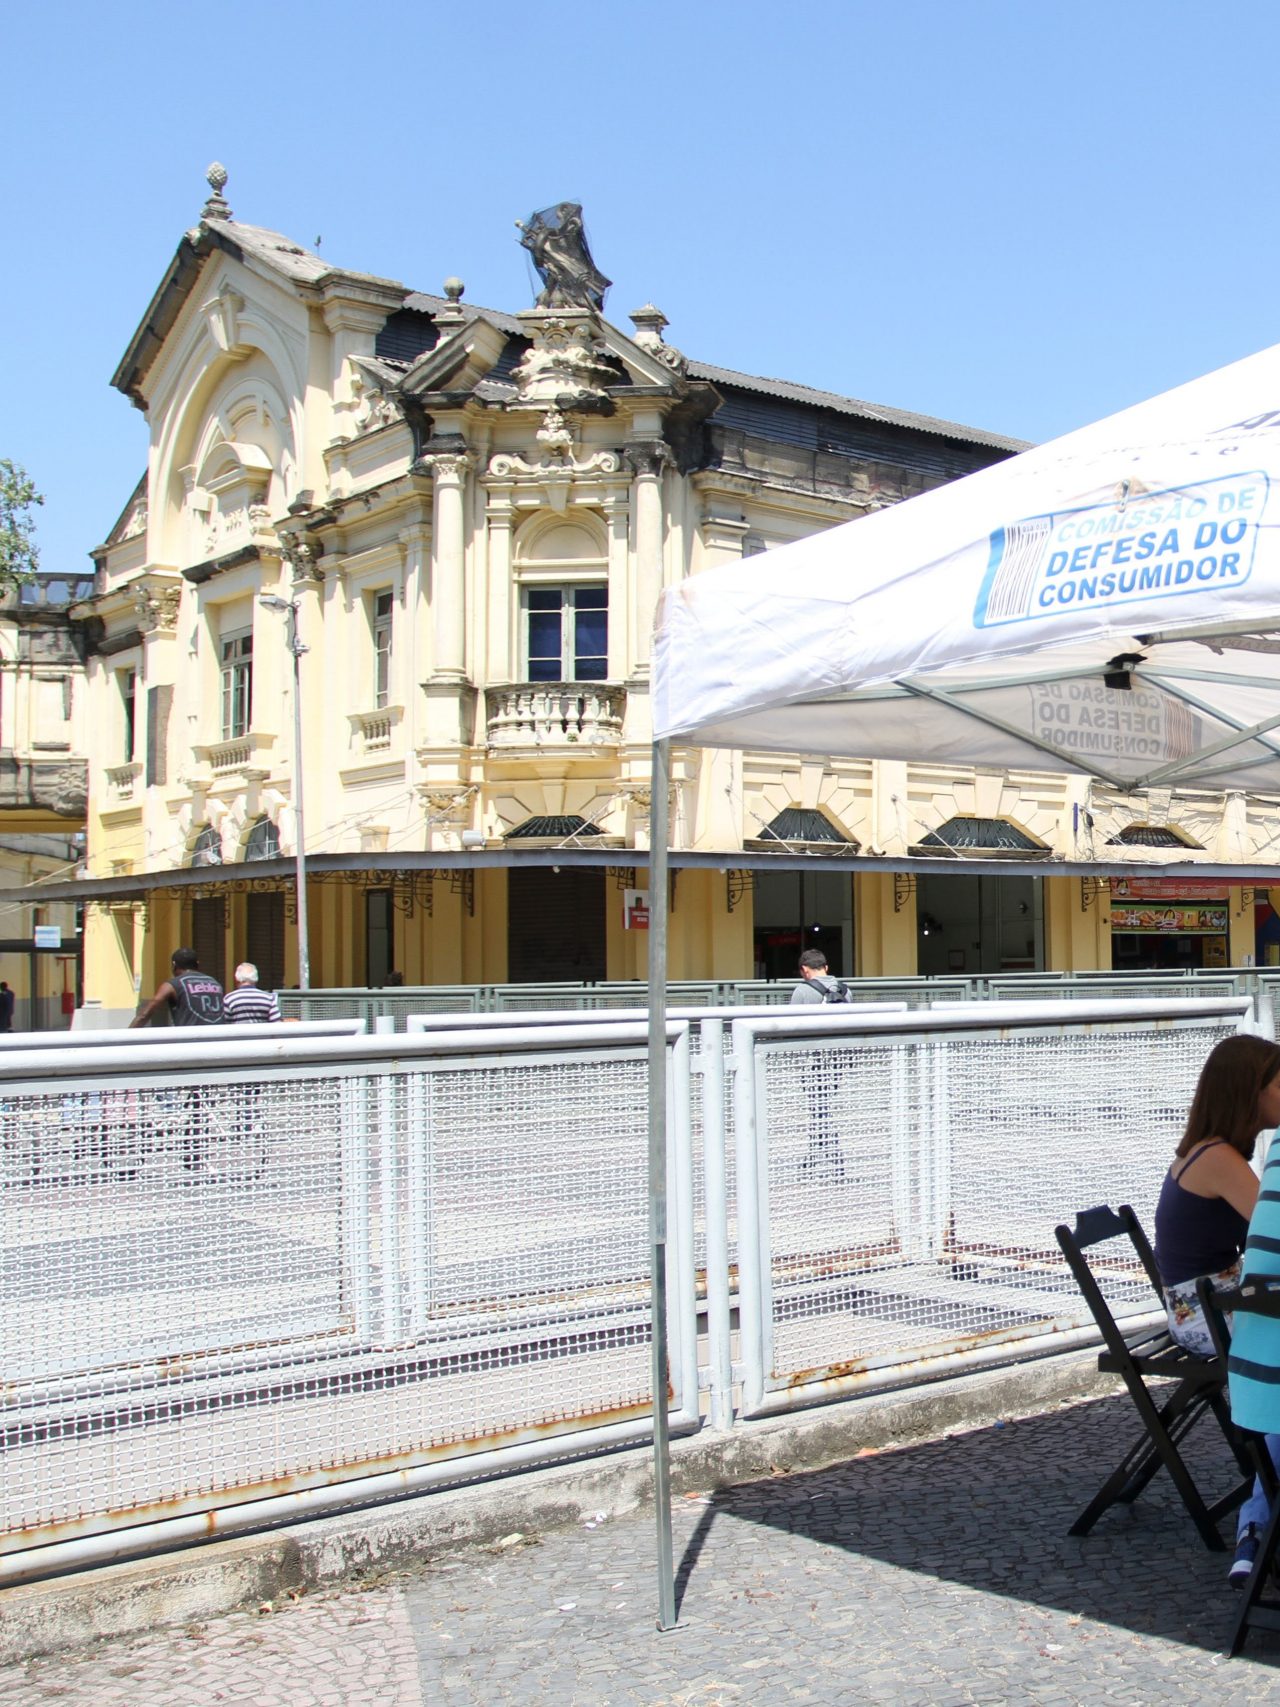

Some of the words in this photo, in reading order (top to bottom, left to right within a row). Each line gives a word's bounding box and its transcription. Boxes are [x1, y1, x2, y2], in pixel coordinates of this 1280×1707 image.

[1058, 497, 1207, 543] COMISSÃO
[1218, 487, 1256, 514] DE
[1045, 528, 1180, 577] DEFESA
[1193, 517, 1248, 550] DO
[1038, 552, 1241, 607] CONSUMIDOR
[200, 995, 220, 1011] RJ
